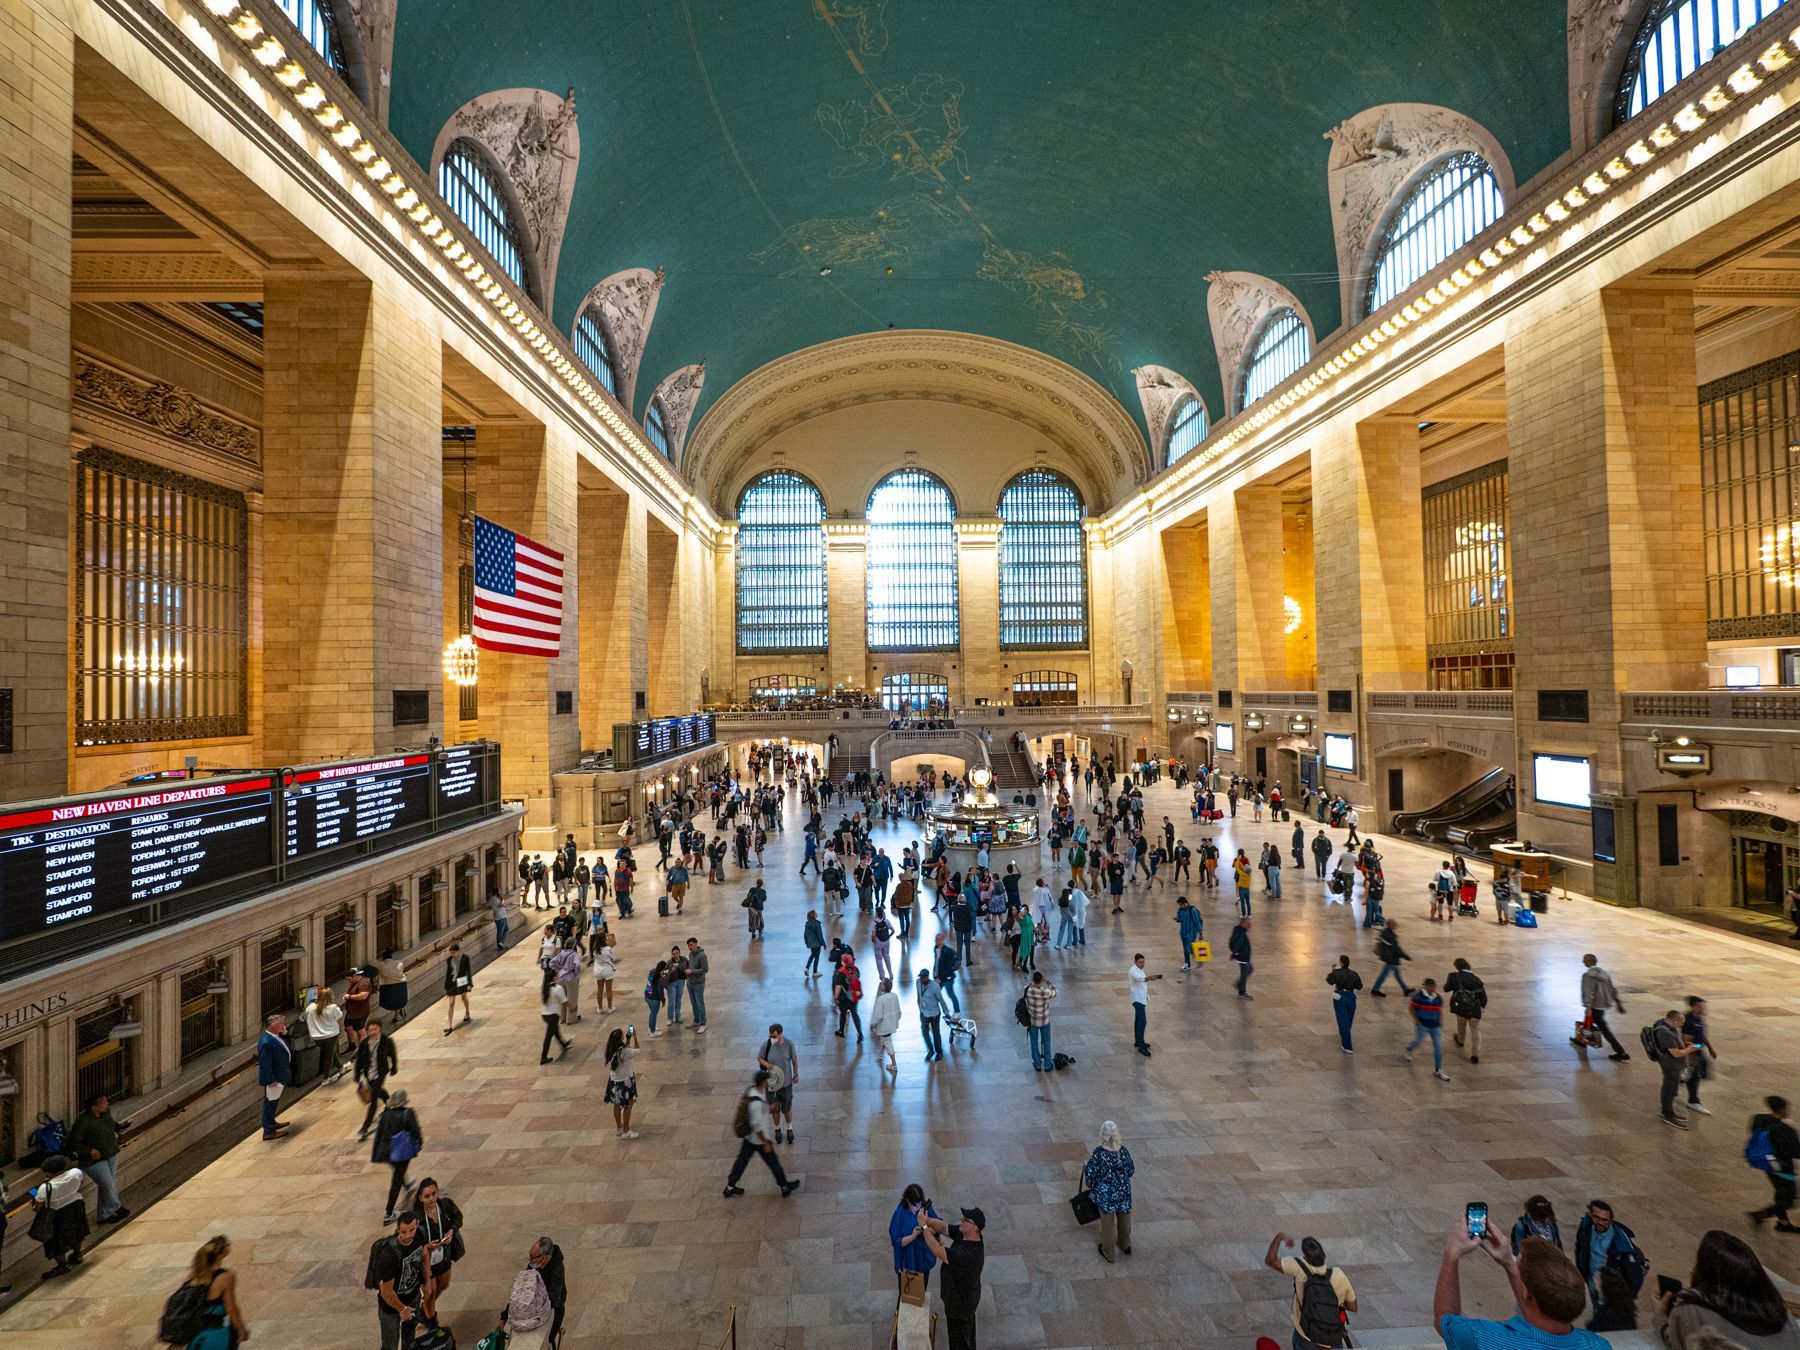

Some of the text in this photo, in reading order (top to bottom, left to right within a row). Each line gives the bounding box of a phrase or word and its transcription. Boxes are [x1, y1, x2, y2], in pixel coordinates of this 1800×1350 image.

[1462, 744, 1487, 756] STREET
[320, 759, 404, 779] NEW HAVEN LINE DEPARTURES
[316, 782, 347, 792] DESTINATION
[52, 785, 226, 821] NEW HAVEN LINE DEPARTURES
[1731, 798, 1766, 808] TRACKS
[131, 812, 169, 825] REMARKS
[131, 824, 168, 837] STAMFORD
[174, 821, 184, 829] 1ST
[185, 818, 202, 827] STOP
[45, 822, 110, 840] DESTINATION
[11, 836, 34, 846] TRK
[46, 838, 95, 854] NEW HAVEN
[46, 851, 95, 868] NEW HAVEN
[131, 849, 166, 862] FORDHAM
[170, 846, 182, 854] 1ST
[182, 841, 199, 851] STOP
[132, 859, 173, 875] GREENWICH
[178, 856, 189, 864] 1ST
[189, 851, 206, 860] STOP
[46, 865, 92, 882] STAMFORD
[131, 873, 166, 887] FORDHAM
[170, 869, 182, 877] 1ST
[182, 864, 200, 874] STOP
[46, 878, 95, 896] NEW HAVEN
[132, 889, 147, 900] RYE
[152, 886, 164, 894] 1ST
[164, 880, 182, 891] STOP
[46, 892, 92, 910] STAMFORD
[46, 905, 92, 924] STAMFORD
